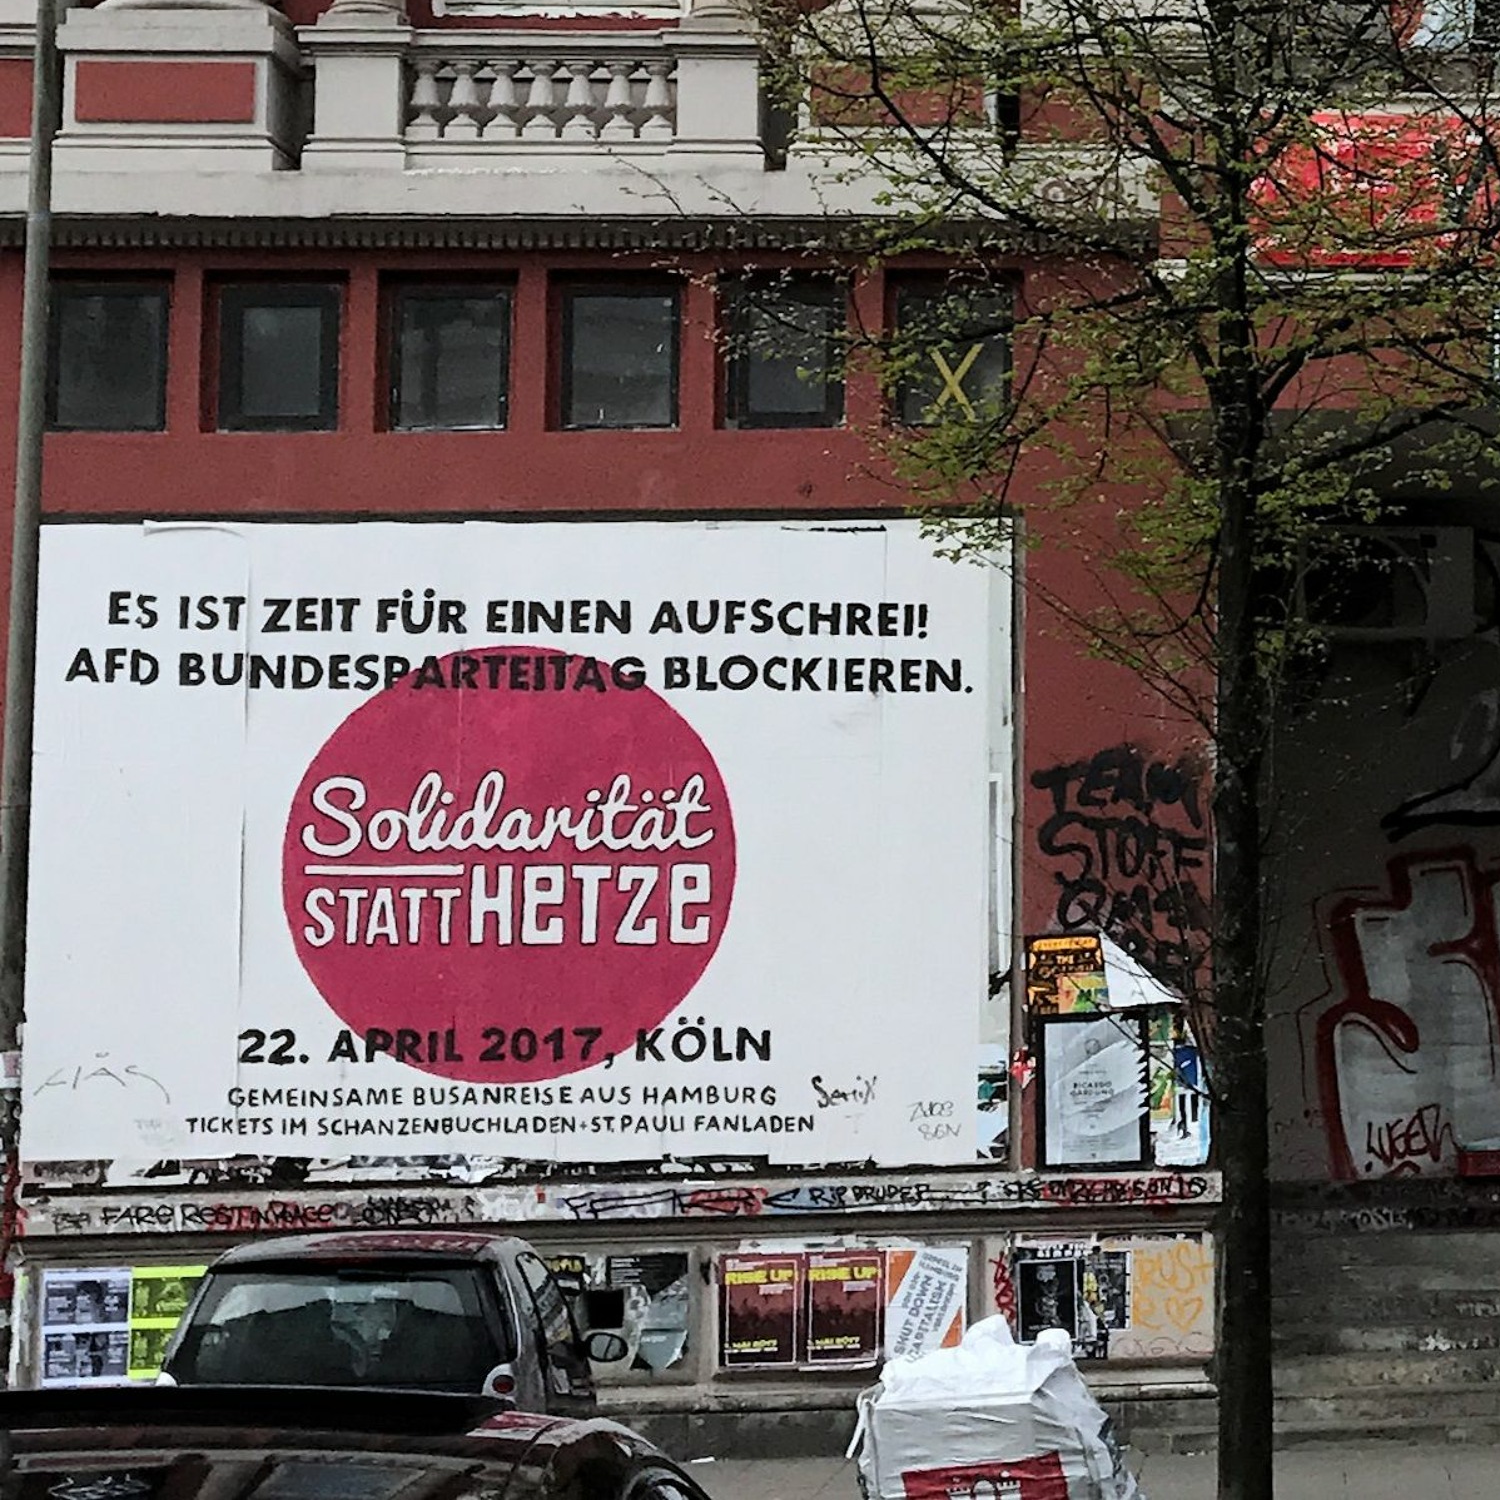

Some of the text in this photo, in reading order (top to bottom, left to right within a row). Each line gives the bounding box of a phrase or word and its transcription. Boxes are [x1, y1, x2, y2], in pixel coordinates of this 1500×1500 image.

[108, 587, 930, 640] ES IST ZEIT FÜR EINEN AUFSCHREI!
[65, 646, 976, 696] AFD BUNDESPARTEITAG BLOCKIEREN.
[302, 771, 715, 858] Solidarität
[303, 887, 463, 947] STATT
[238, 1015, 772, 1070] 22. APRIL 2017, KÖLN
[226, 1084, 778, 1109] GEMEINSAME BUSANREISE AUS HAMBURG
[185, 1115, 274, 1136] TICKETS
[281, 1116, 308, 1137] IM
[694, 1113, 815, 1133] FANLADEN
